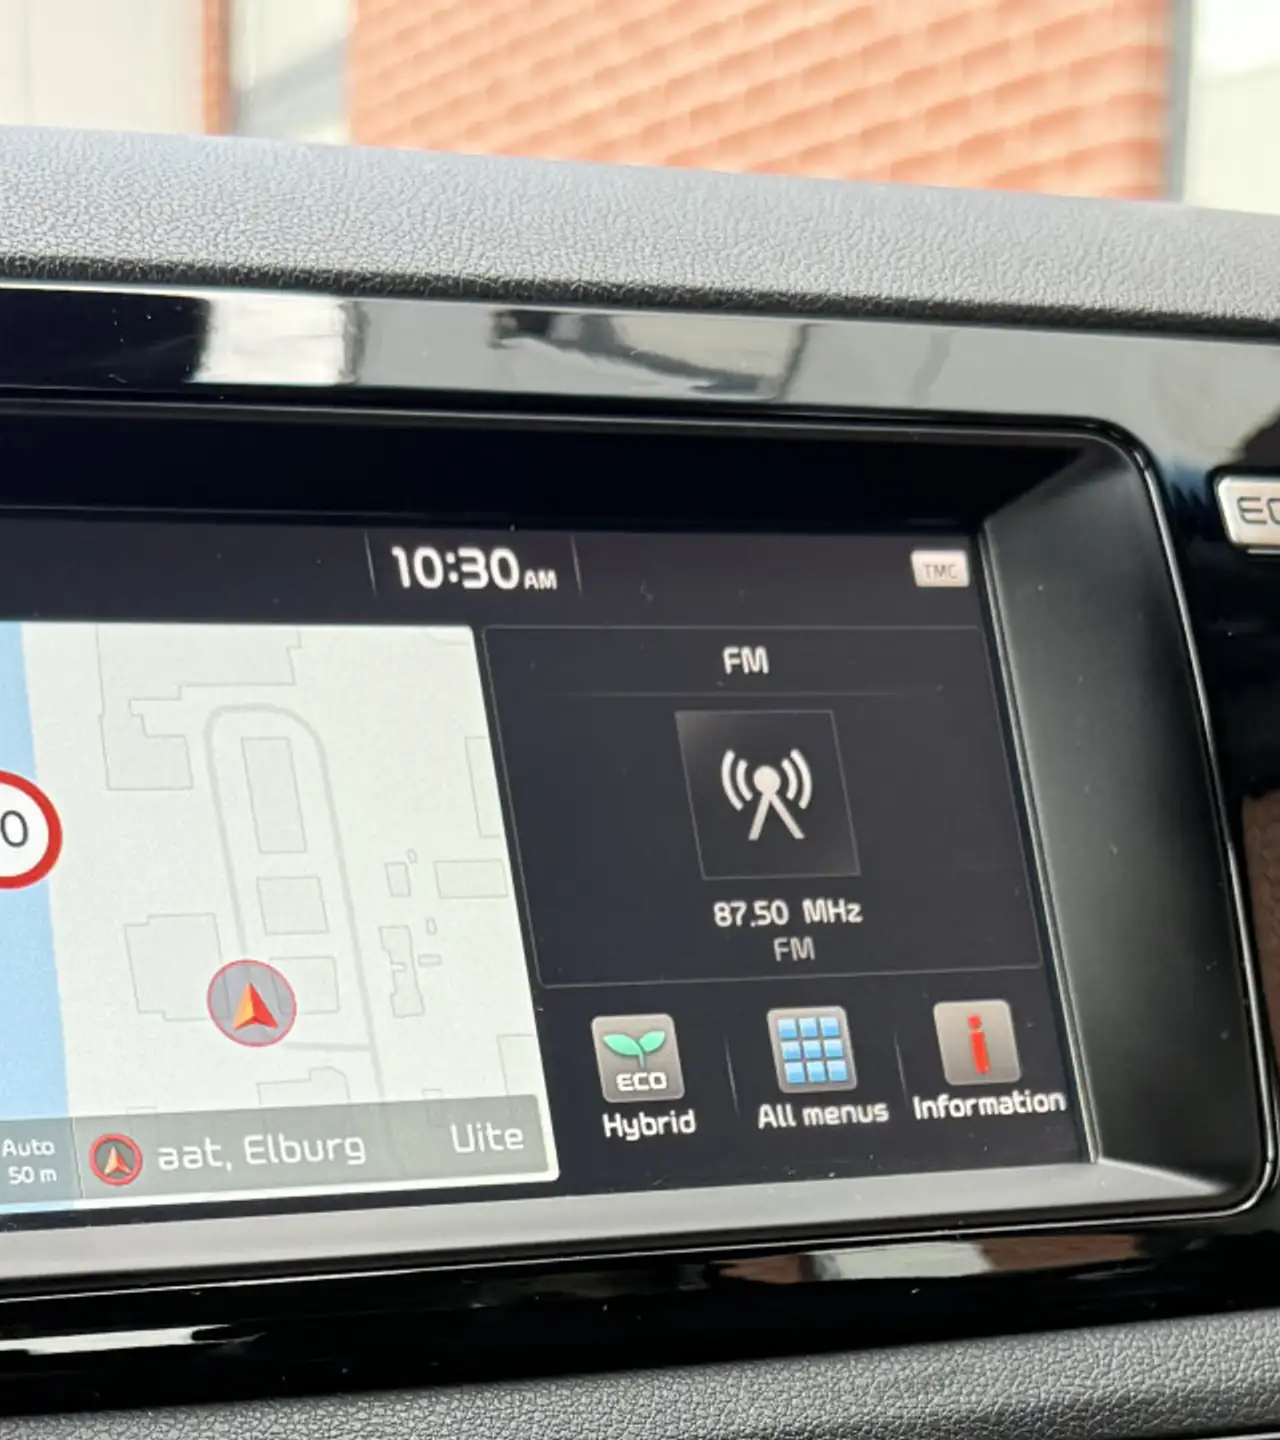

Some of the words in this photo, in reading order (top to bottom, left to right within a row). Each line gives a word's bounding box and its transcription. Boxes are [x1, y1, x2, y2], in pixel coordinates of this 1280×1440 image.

[391, 545, 520, 591] 10:30
[524, 569, 558, 591] AM
[921, 562, 959, 581] TMC
[722, 646, 770, 676] FM
[713, 899, 789, 928] 87.50
[803, 898, 863, 926] MHz
[773, 937, 816, 963] FM
[616, 1071, 668, 1092] ECO
[757, 1103, 801, 1129] All
[803, 1101, 889, 1126] menus
[912, 1089, 1067, 1121] Information
[602, 1109, 697, 1142] Hybrid
[1, 1136, 56, 1158] Auto
[243, 1132, 366, 1168] Elburg
[449, 1121, 524, 1156] Uite
[8, 1166, 36, 1185] 50
[40, 1168, 58, 1184] m
